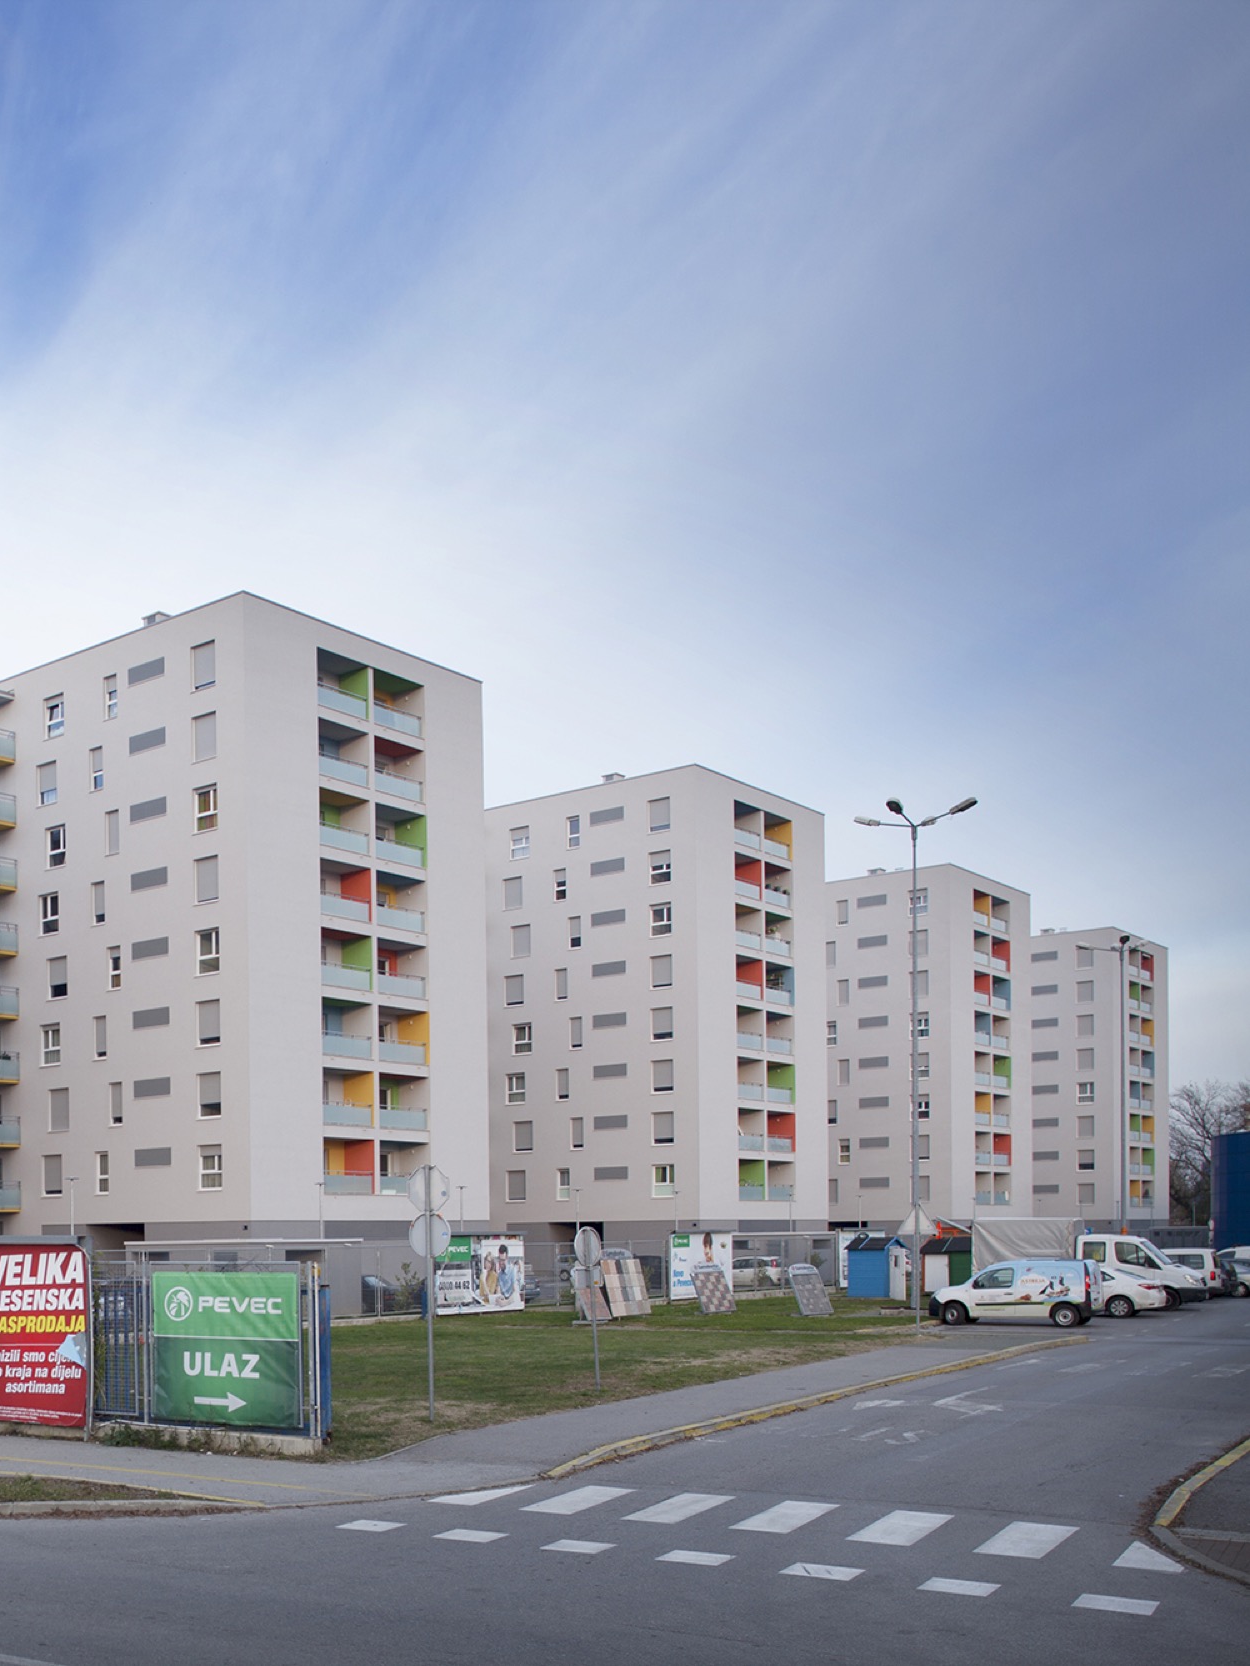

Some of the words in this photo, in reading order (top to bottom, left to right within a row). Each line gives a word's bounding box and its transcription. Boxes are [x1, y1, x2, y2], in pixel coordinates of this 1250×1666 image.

[198, 1296, 282, 1315] PEVEC
[22, 1351, 46, 1363] smo
[183, 1351, 260, 1379] ULAZ
[5, 1365, 32, 1381] kraja
[34, 1367, 49, 1379] na
[50, 1365, 82, 1381] dijelu
[5, 1380, 66, 1395] asortimana
